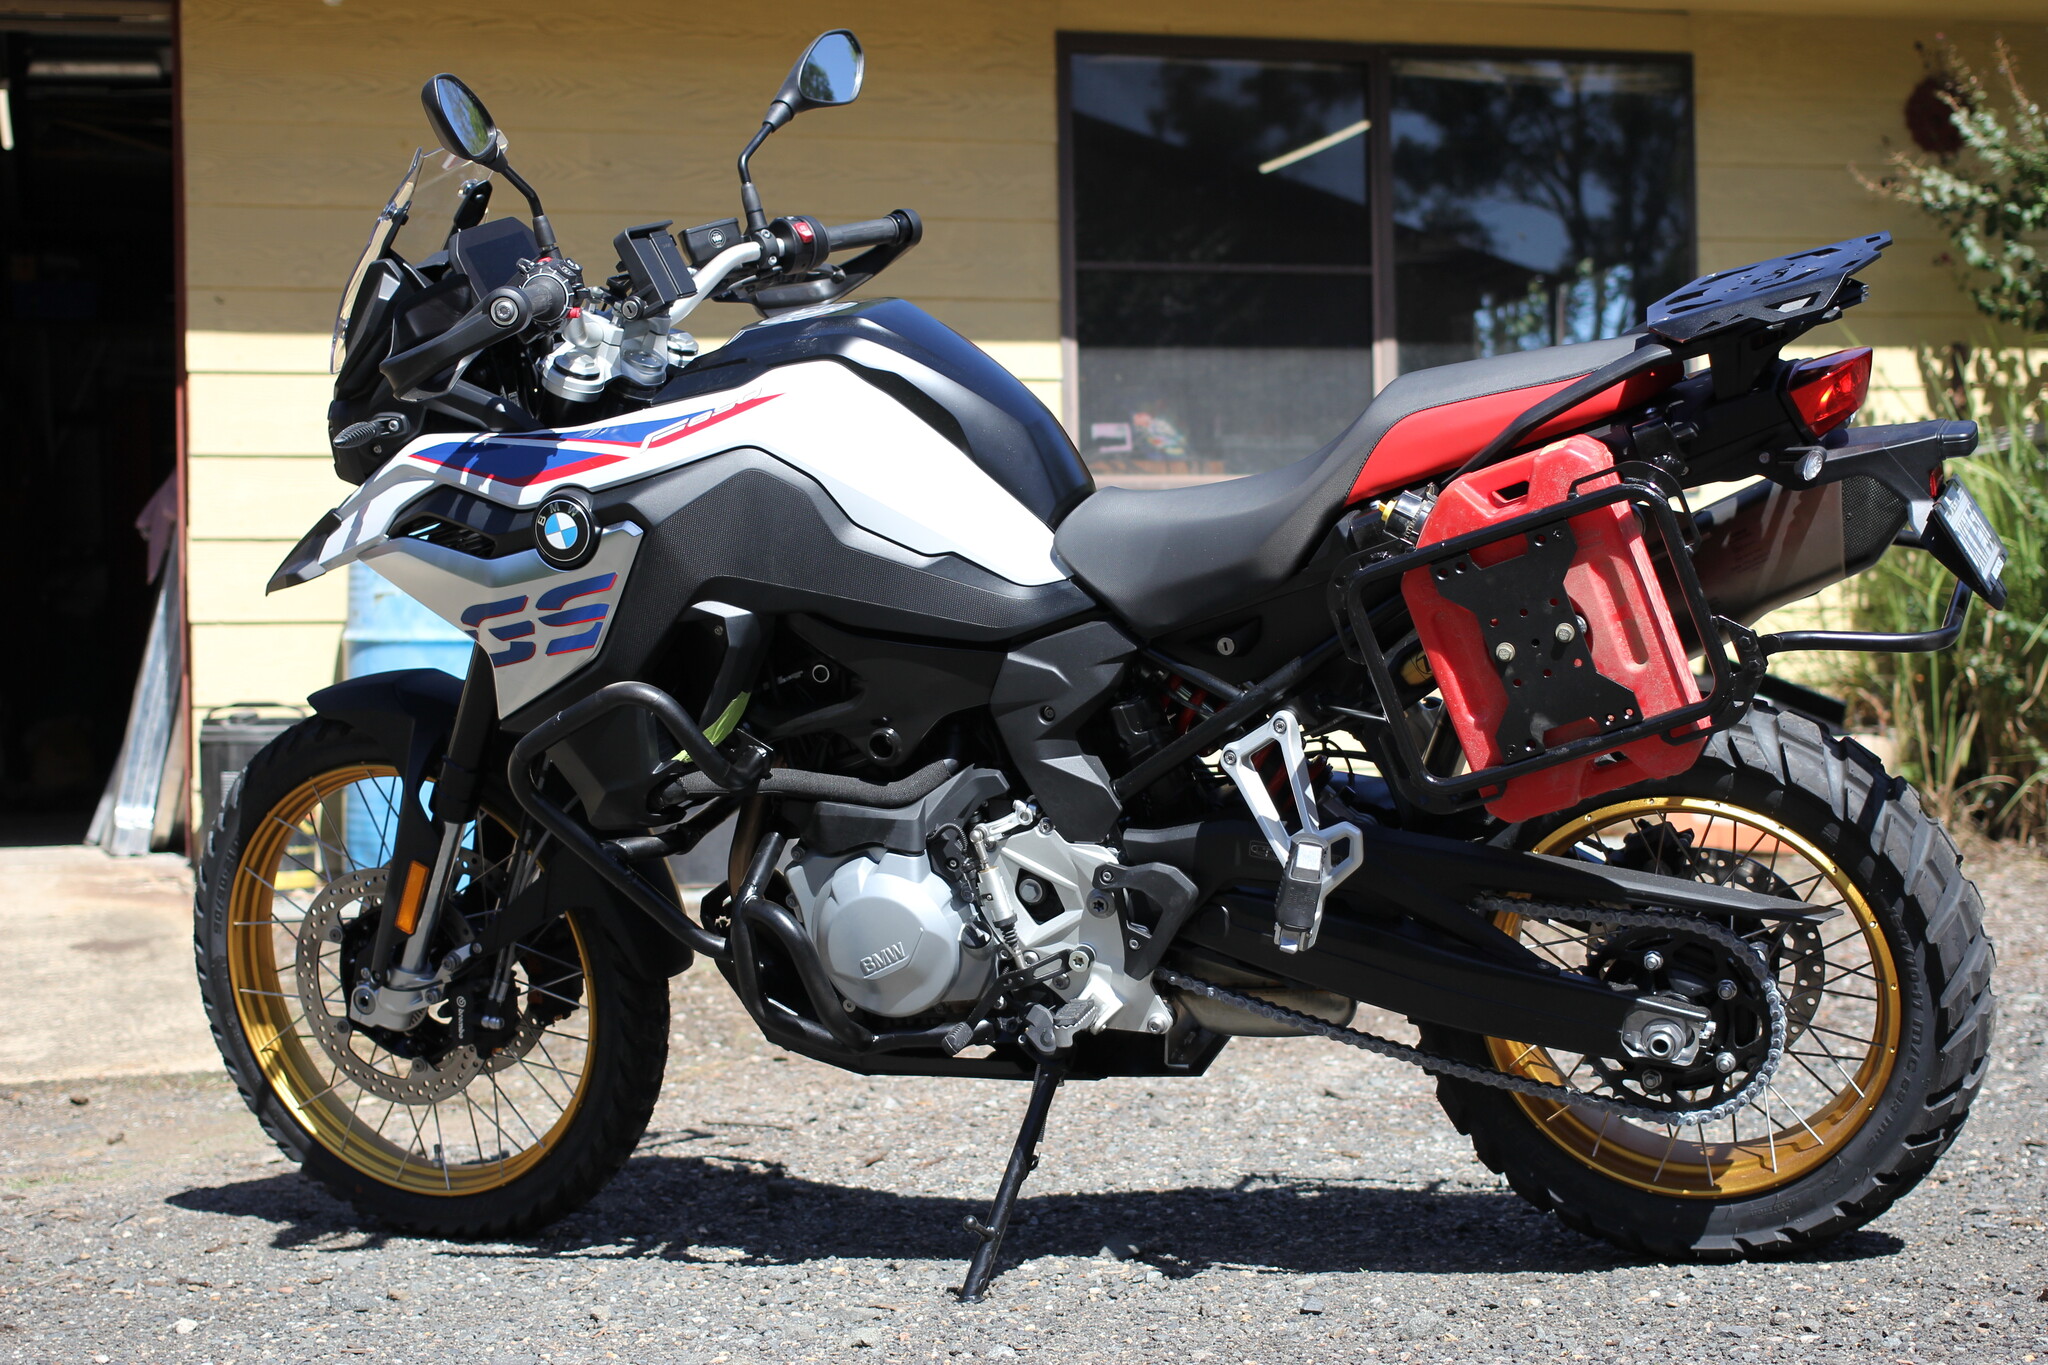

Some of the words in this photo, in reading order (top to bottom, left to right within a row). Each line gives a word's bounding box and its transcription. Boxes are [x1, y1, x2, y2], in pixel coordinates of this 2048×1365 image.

[537, 501, 580, 527] BMW
[460, 571, 619, 669] GS
[860, 941, 906, 974] BMW
